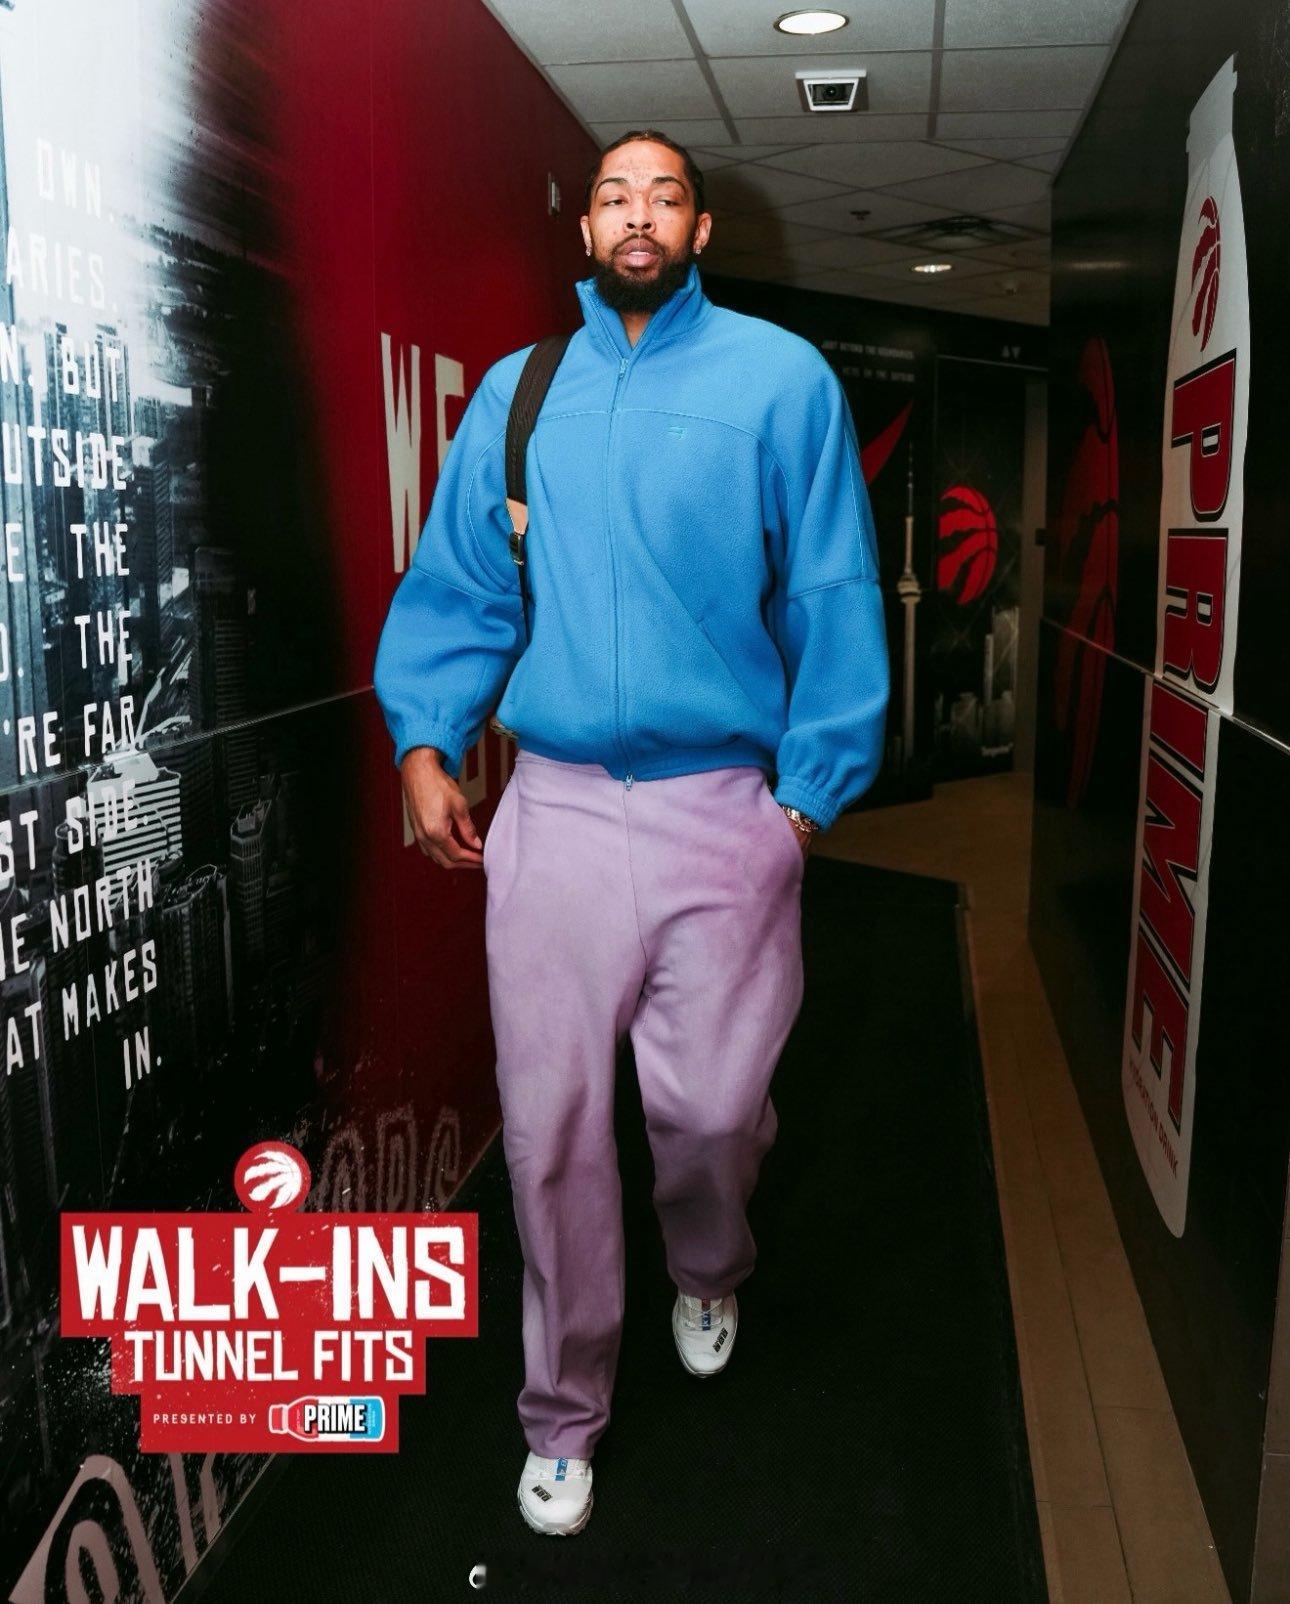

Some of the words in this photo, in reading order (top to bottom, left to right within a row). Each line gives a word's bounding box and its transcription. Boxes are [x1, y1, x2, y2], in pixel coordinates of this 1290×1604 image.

[61, 336, 120, 402] BUT
[69, 521, 130, 579] THE
[73, 610, 133, 670] THE
[83, 695, 136, 757] FAR
[1130, 348, 1237, 1136] PRIME
[50, 858, 154, 953] NORTH
[6, 1001, 43, 1076] AT
[61, 939, 158, 1041] MAKES
[122, 1025, 163, 1090] IN.
